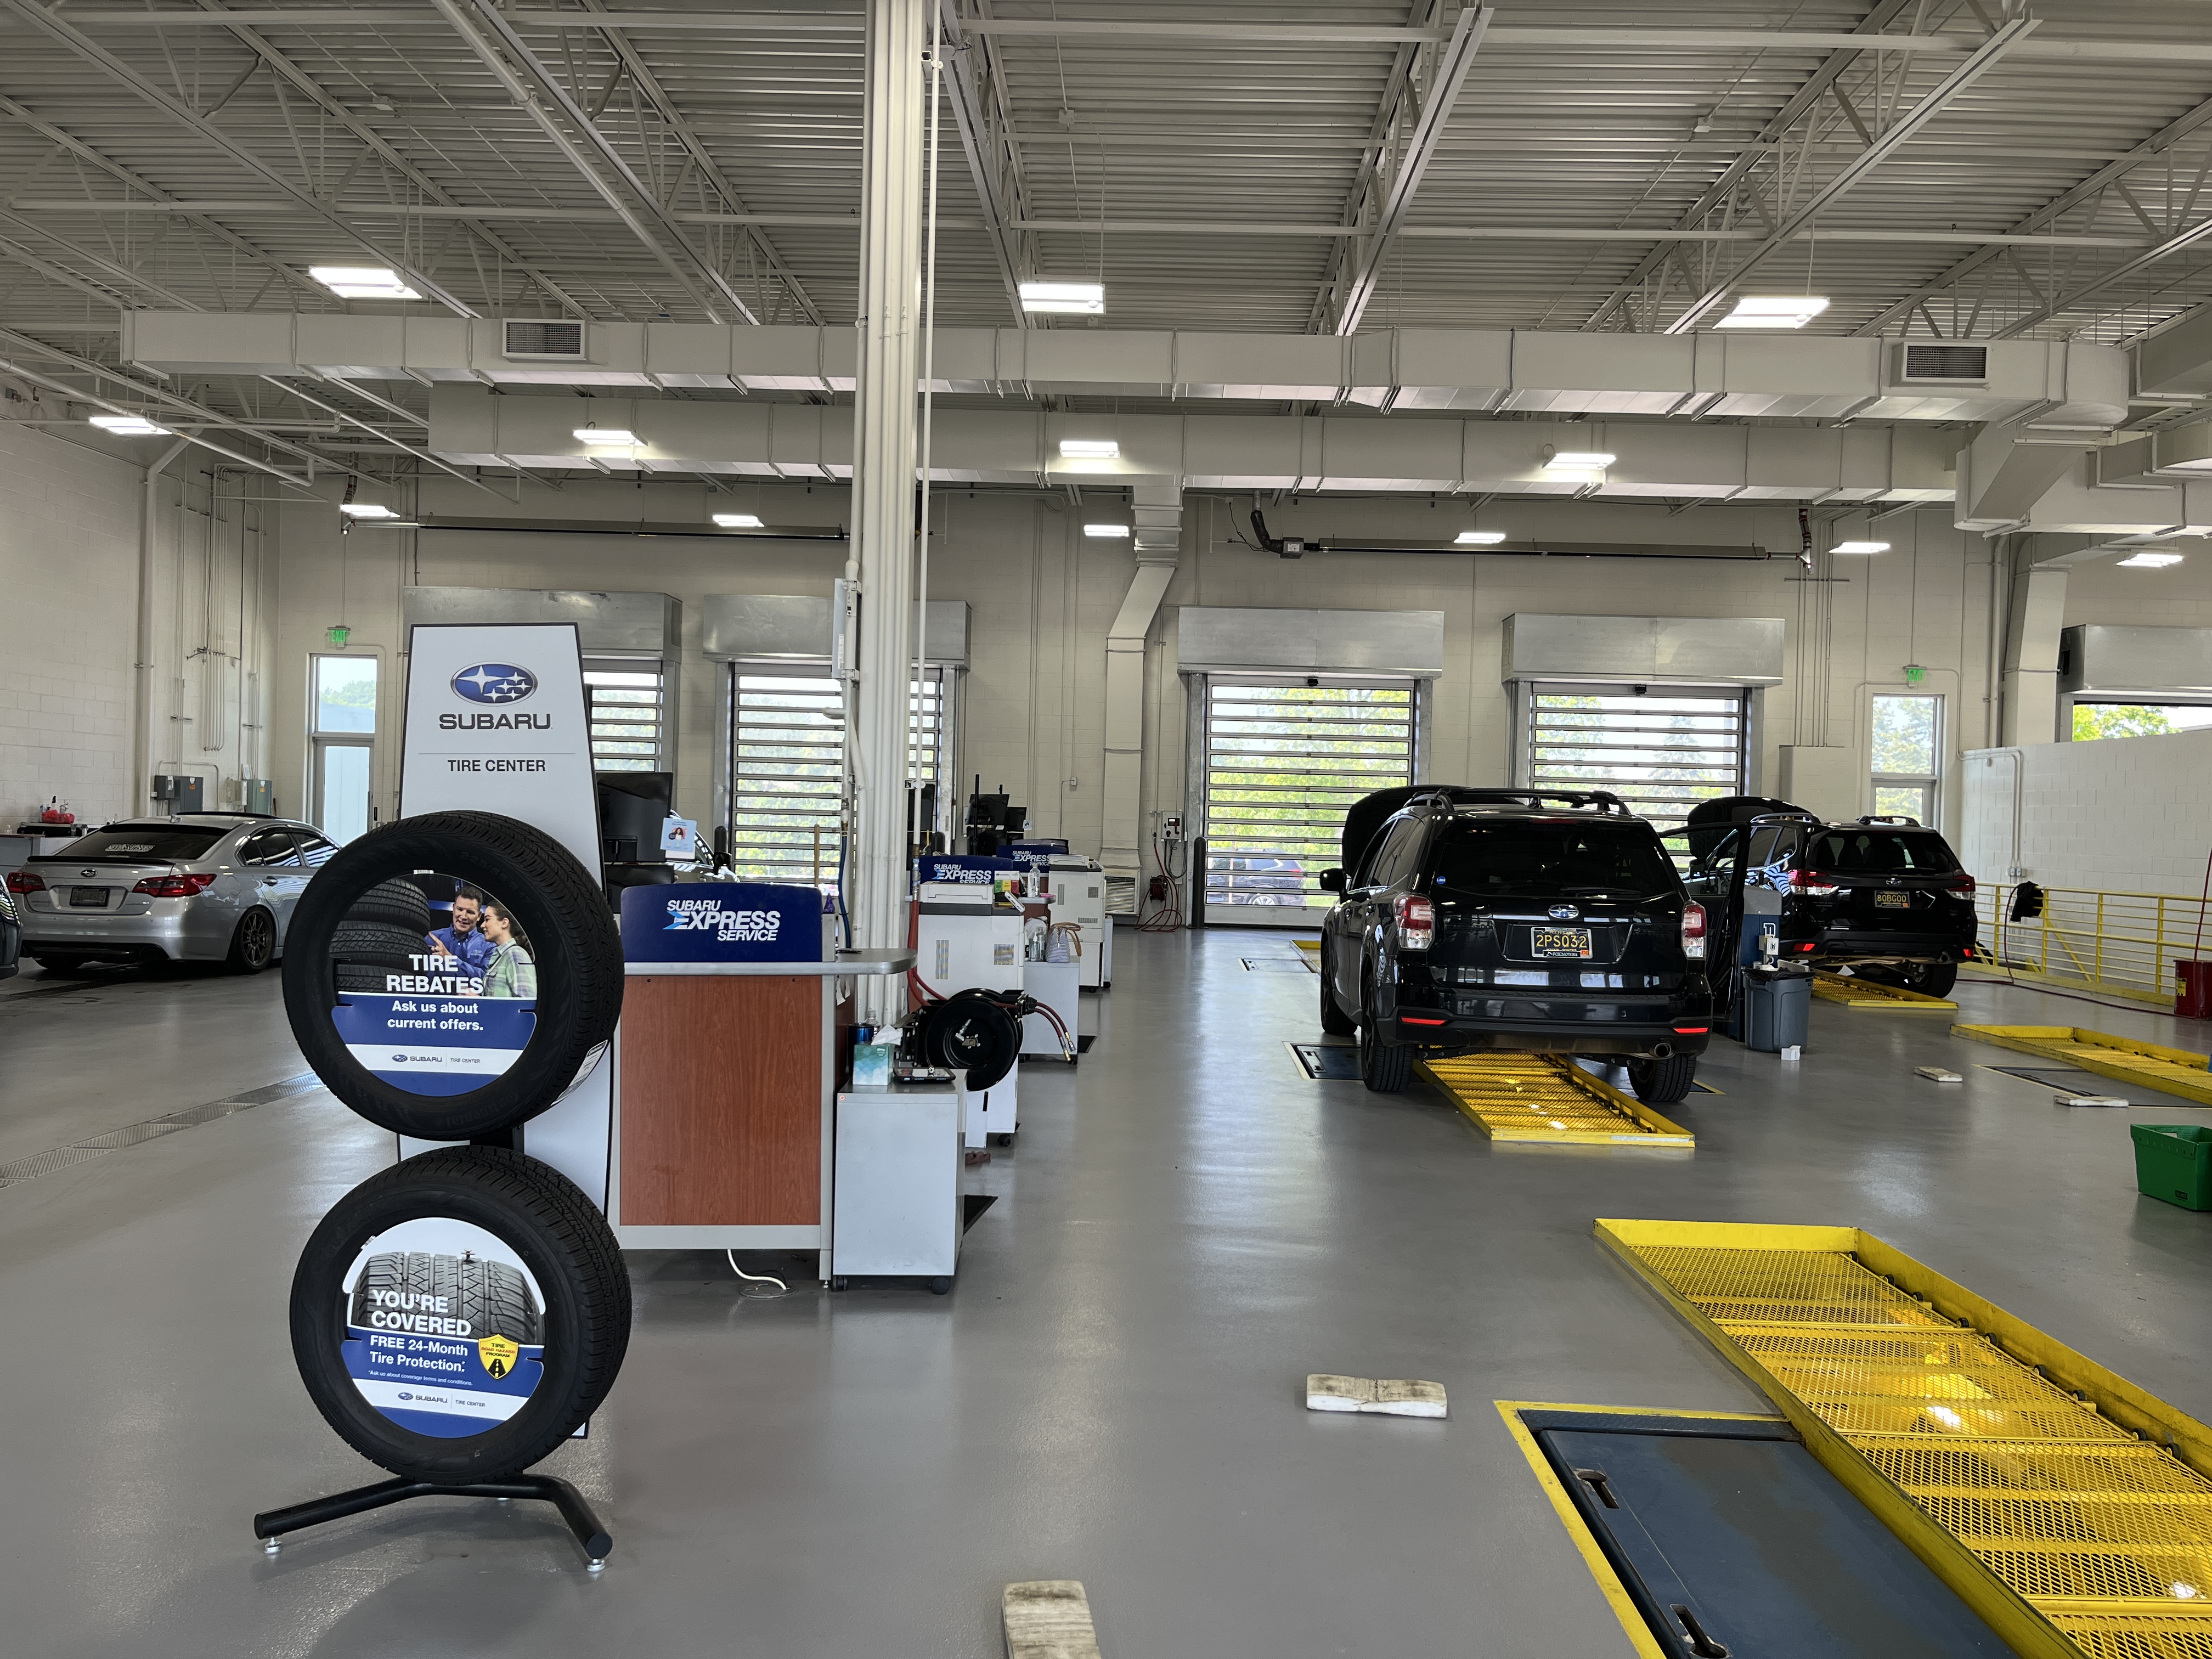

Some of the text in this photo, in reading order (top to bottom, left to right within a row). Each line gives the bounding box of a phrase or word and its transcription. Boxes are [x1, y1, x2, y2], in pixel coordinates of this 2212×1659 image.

[331, 630, 346, 642] EXIT
[439, 714, 550, 730] SUBARU
[448, 760, 546, 772] TIRE CENTER
[932, 870, 992, 879] EXPRESS
[667, 900, 721, 911] SUBARU
[663, 911, 781, 929] EXPRESS
[717, 930, 778, 941] SERVICE
[1536, 934, 1587, 948] 2PSQ32
[409, 954, 459, 972] TIRE
[386, 974, 483, 994] REBATES
[392, 1000, 478, 1014] Ask us about
[387, 1018, 483, 1031] current offers.
[372, 1289, 448, 1313] YOU'RE
[371, 1310, 471, 1336] COVERED
[370, 1335, 467, 1356] FREE 24-Month
[370, 1351, 394, 1364] Tire
[415, 1395, 448, 1403] SUBARU
